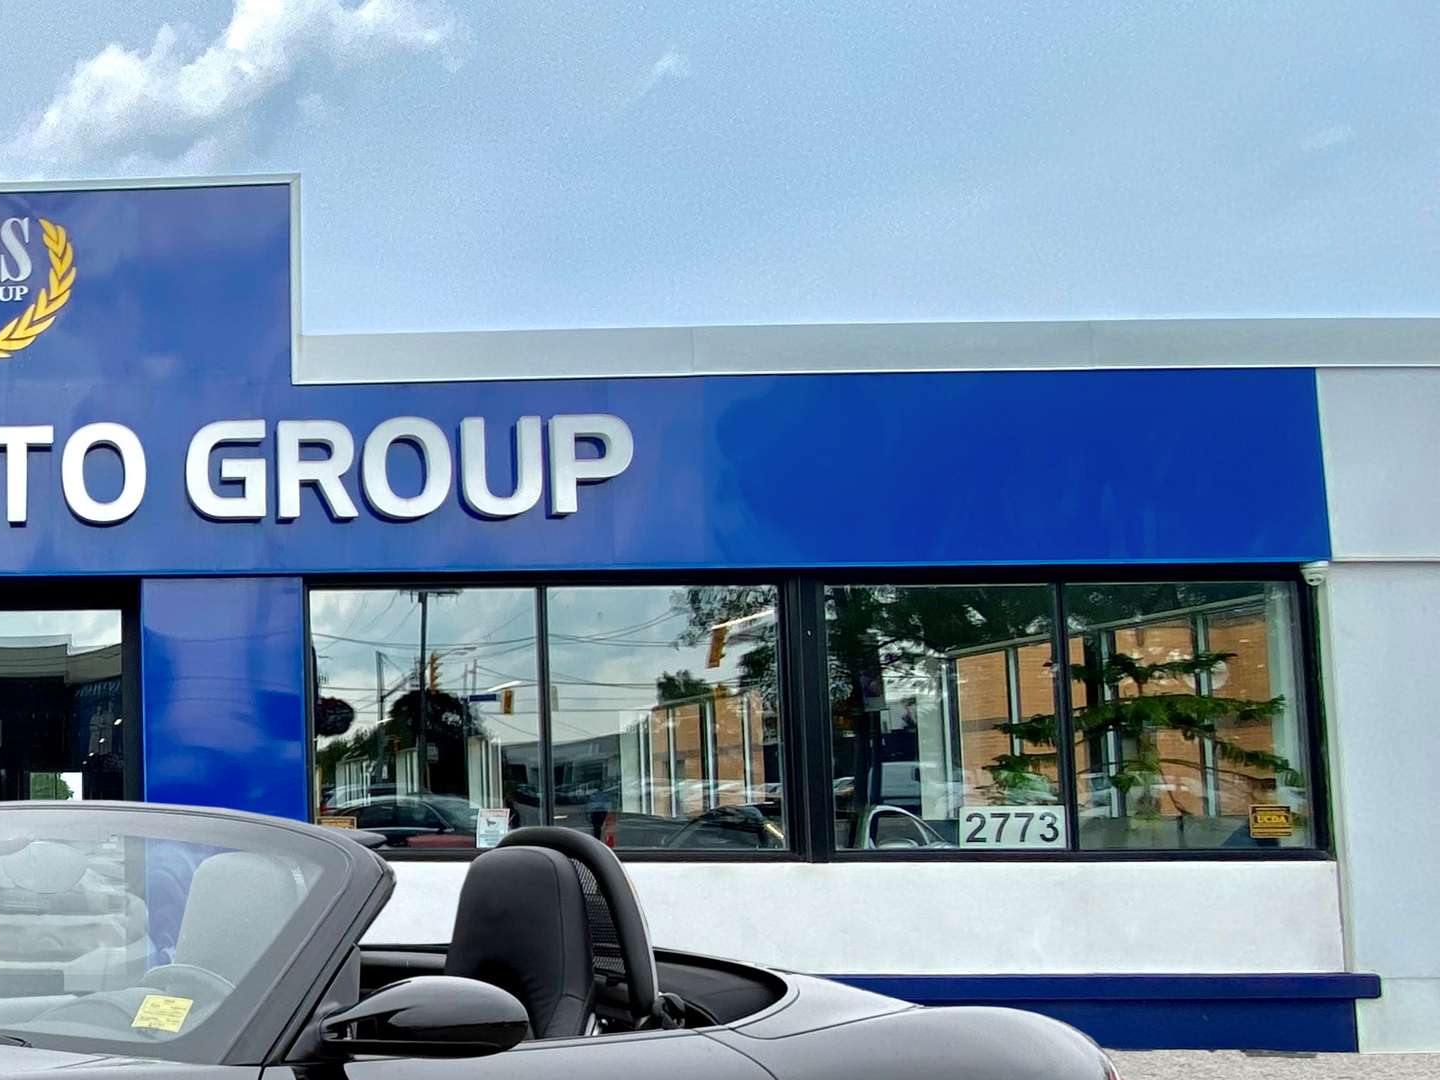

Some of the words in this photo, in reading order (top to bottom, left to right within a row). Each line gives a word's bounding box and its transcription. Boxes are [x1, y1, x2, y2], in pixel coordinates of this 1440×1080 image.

[184, 413, 634, 523] GROUP
[965, 812, 1060, 842] 2773
[1256, 814, 1287, 824] UCDA
